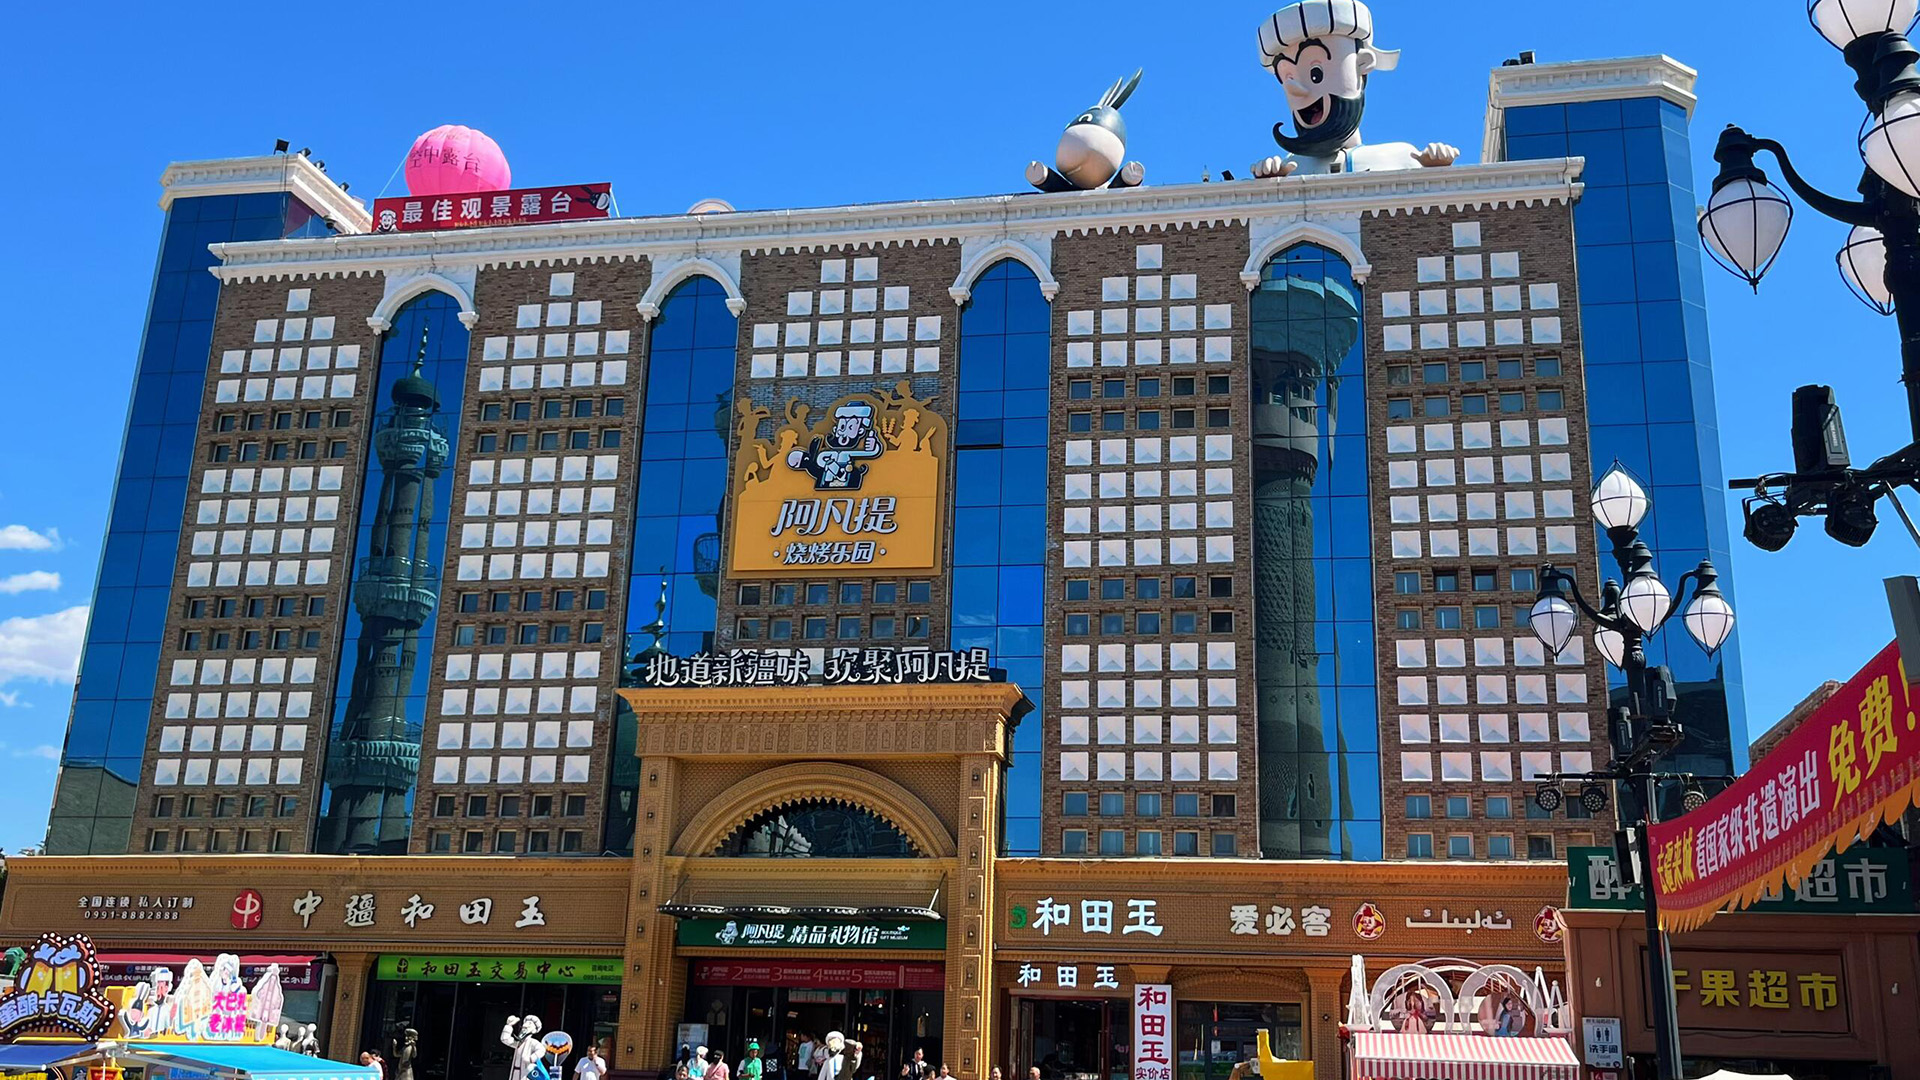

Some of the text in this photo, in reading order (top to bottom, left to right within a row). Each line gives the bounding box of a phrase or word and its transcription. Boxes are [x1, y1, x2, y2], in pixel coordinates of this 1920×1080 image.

[409, 145, 481, 173] 空中露台
[402, 191, 573, 223] 最佳观景露台
[769, 496, 898, 537] 阿凡提
[783, 541, 876, 564] 烧烤乐园
[645, 648, 992, 687] 地道新疆味 欢聚阿凡提
[1696, 750, 1821, 879] 看国家级非遗演出
[78, 896, 193, 908] 全国连锁 私人订制
[84, 910, 179, 920] 0991-8882888
[293, 890, 546, 928] 中疆和田玉
[1032, 896, 1163, 936] 和田玉
[741, 924, 879, 945] 阿凡提 精品礼物馆
[1230, 905, 1331, 936] 爱必客
[421, 960, 576, 981] 和田玉交易中心
[1017, 963, 1119, 989] 和田玉
[1137, 986, 1169, 1065] 和田玉
[1135, 1067, 1171, 1080] 实价店
